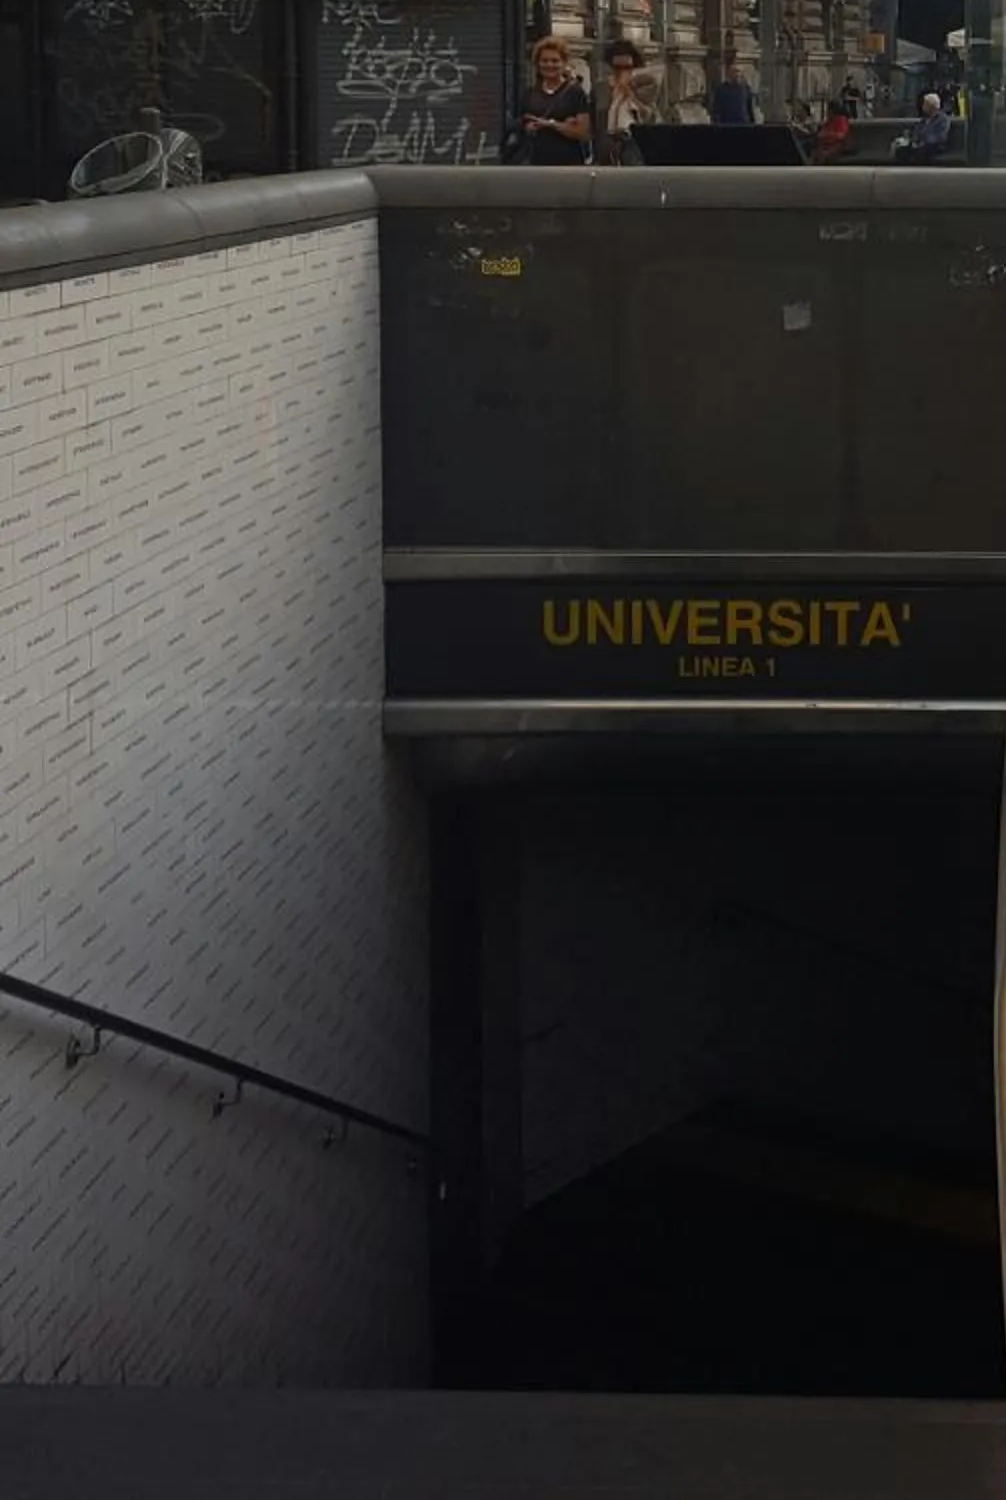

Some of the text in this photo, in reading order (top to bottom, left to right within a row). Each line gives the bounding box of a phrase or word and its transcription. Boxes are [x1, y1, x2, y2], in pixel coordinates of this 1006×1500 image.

[542, 598, 912, 647] UNIVERSITA'
[678, 656, 777, 678] LINEA 1
